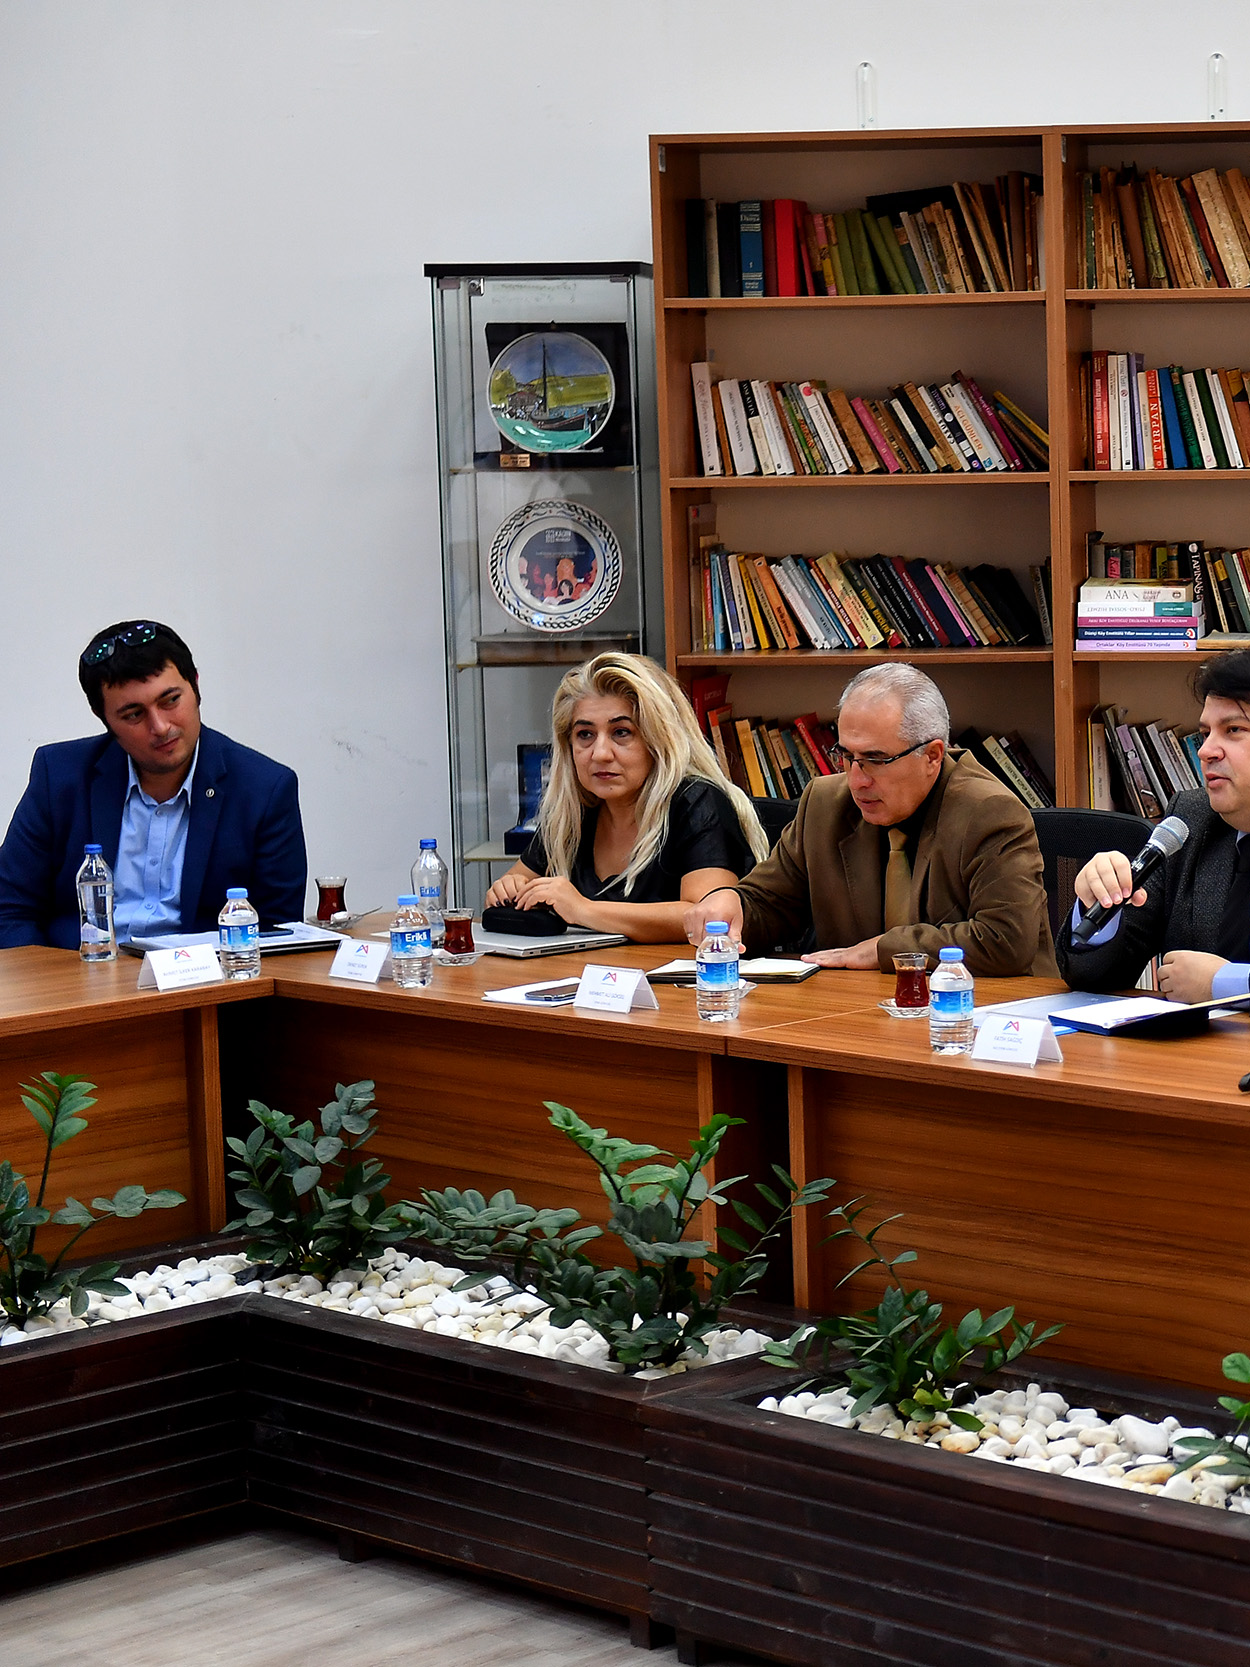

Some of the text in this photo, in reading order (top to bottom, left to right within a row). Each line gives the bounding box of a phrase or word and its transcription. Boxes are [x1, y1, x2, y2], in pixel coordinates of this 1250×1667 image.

[953, 405, 984, 451] ACI GÜNLER
[1150, 403, 1161, 453] TIRPAN
[1105, 589, 1129, 600] ANA
[405, 932, 427, 942] Erikli
